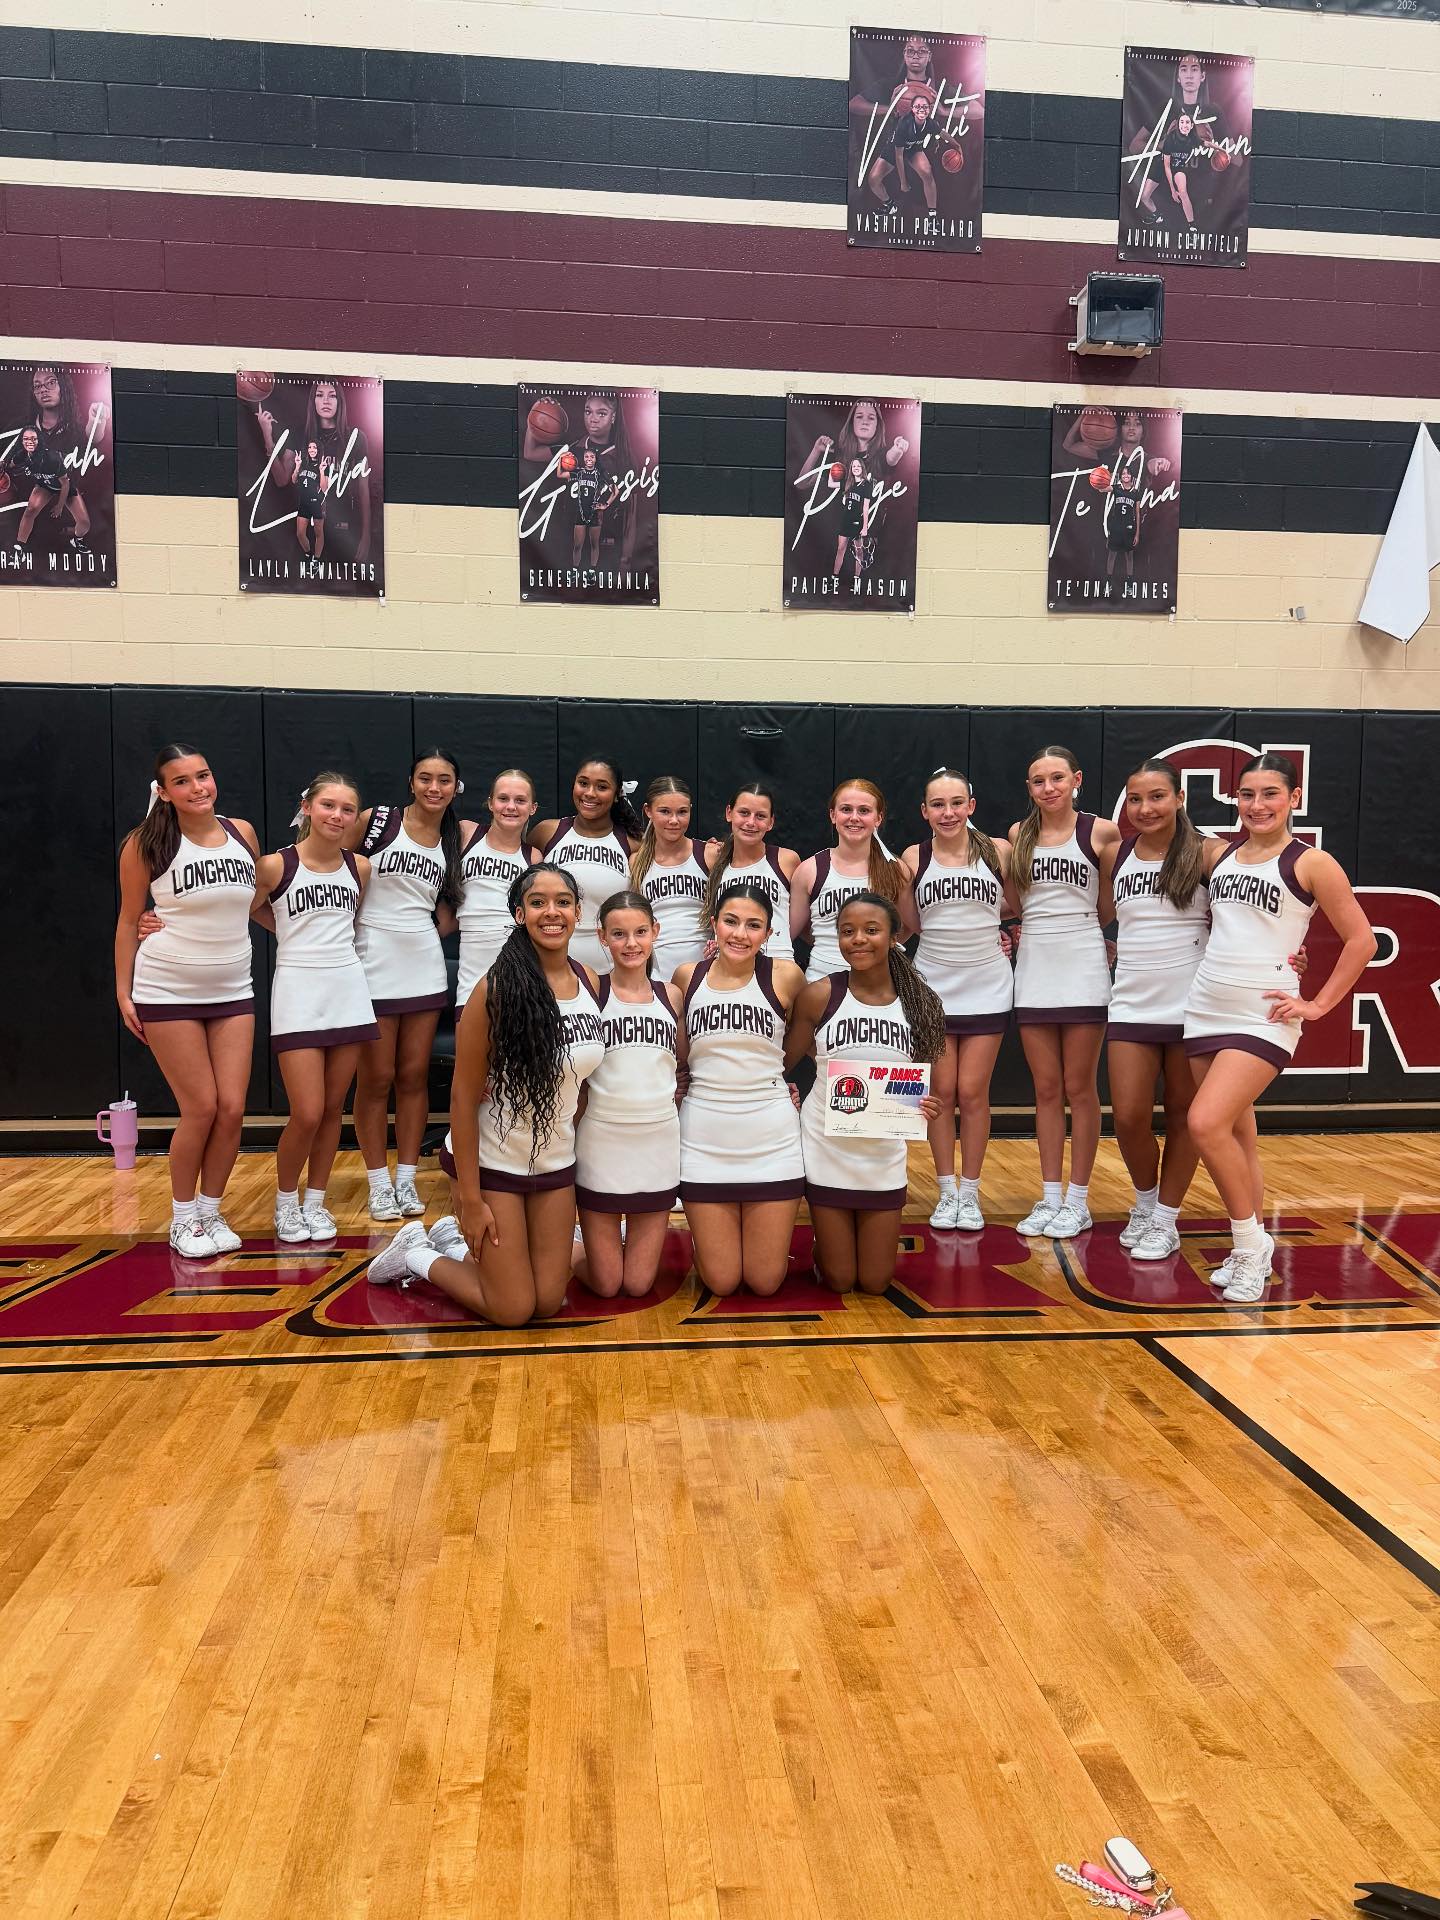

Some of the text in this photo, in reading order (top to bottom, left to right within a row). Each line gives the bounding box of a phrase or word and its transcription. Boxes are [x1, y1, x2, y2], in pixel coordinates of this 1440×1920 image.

[1396, 0, 1417, 11] 2025
[856, 213, 973, 239] VASHTI POLLARD
[1127, 228, 1170, 249] AUTUMN
[48, 552, 107, 572] MOODY
[249, 558, 289, 578] LAYLA
[529, 569, 649, 590] GENESIS OBANLA
[791, 576, 907, 597] PAIGE MASON
[1056, 579, 1168, 599] TE'ONA JONES
[378, 850, 446, 892] LONGHORN
[552, 844, 626, 877] LONGHORNS
[918, 876, 998, 910] LONGHORNS
[1210, 874, 1281, 914] ONGHORNS
[602, 1016, 677, 1055] ONGHORNS
[869, 1066, 924, 1082] TOP DANCE
[884, 1081, 924, 1096] AWARD
[831, 1097, 868, 1108] CHAMP
